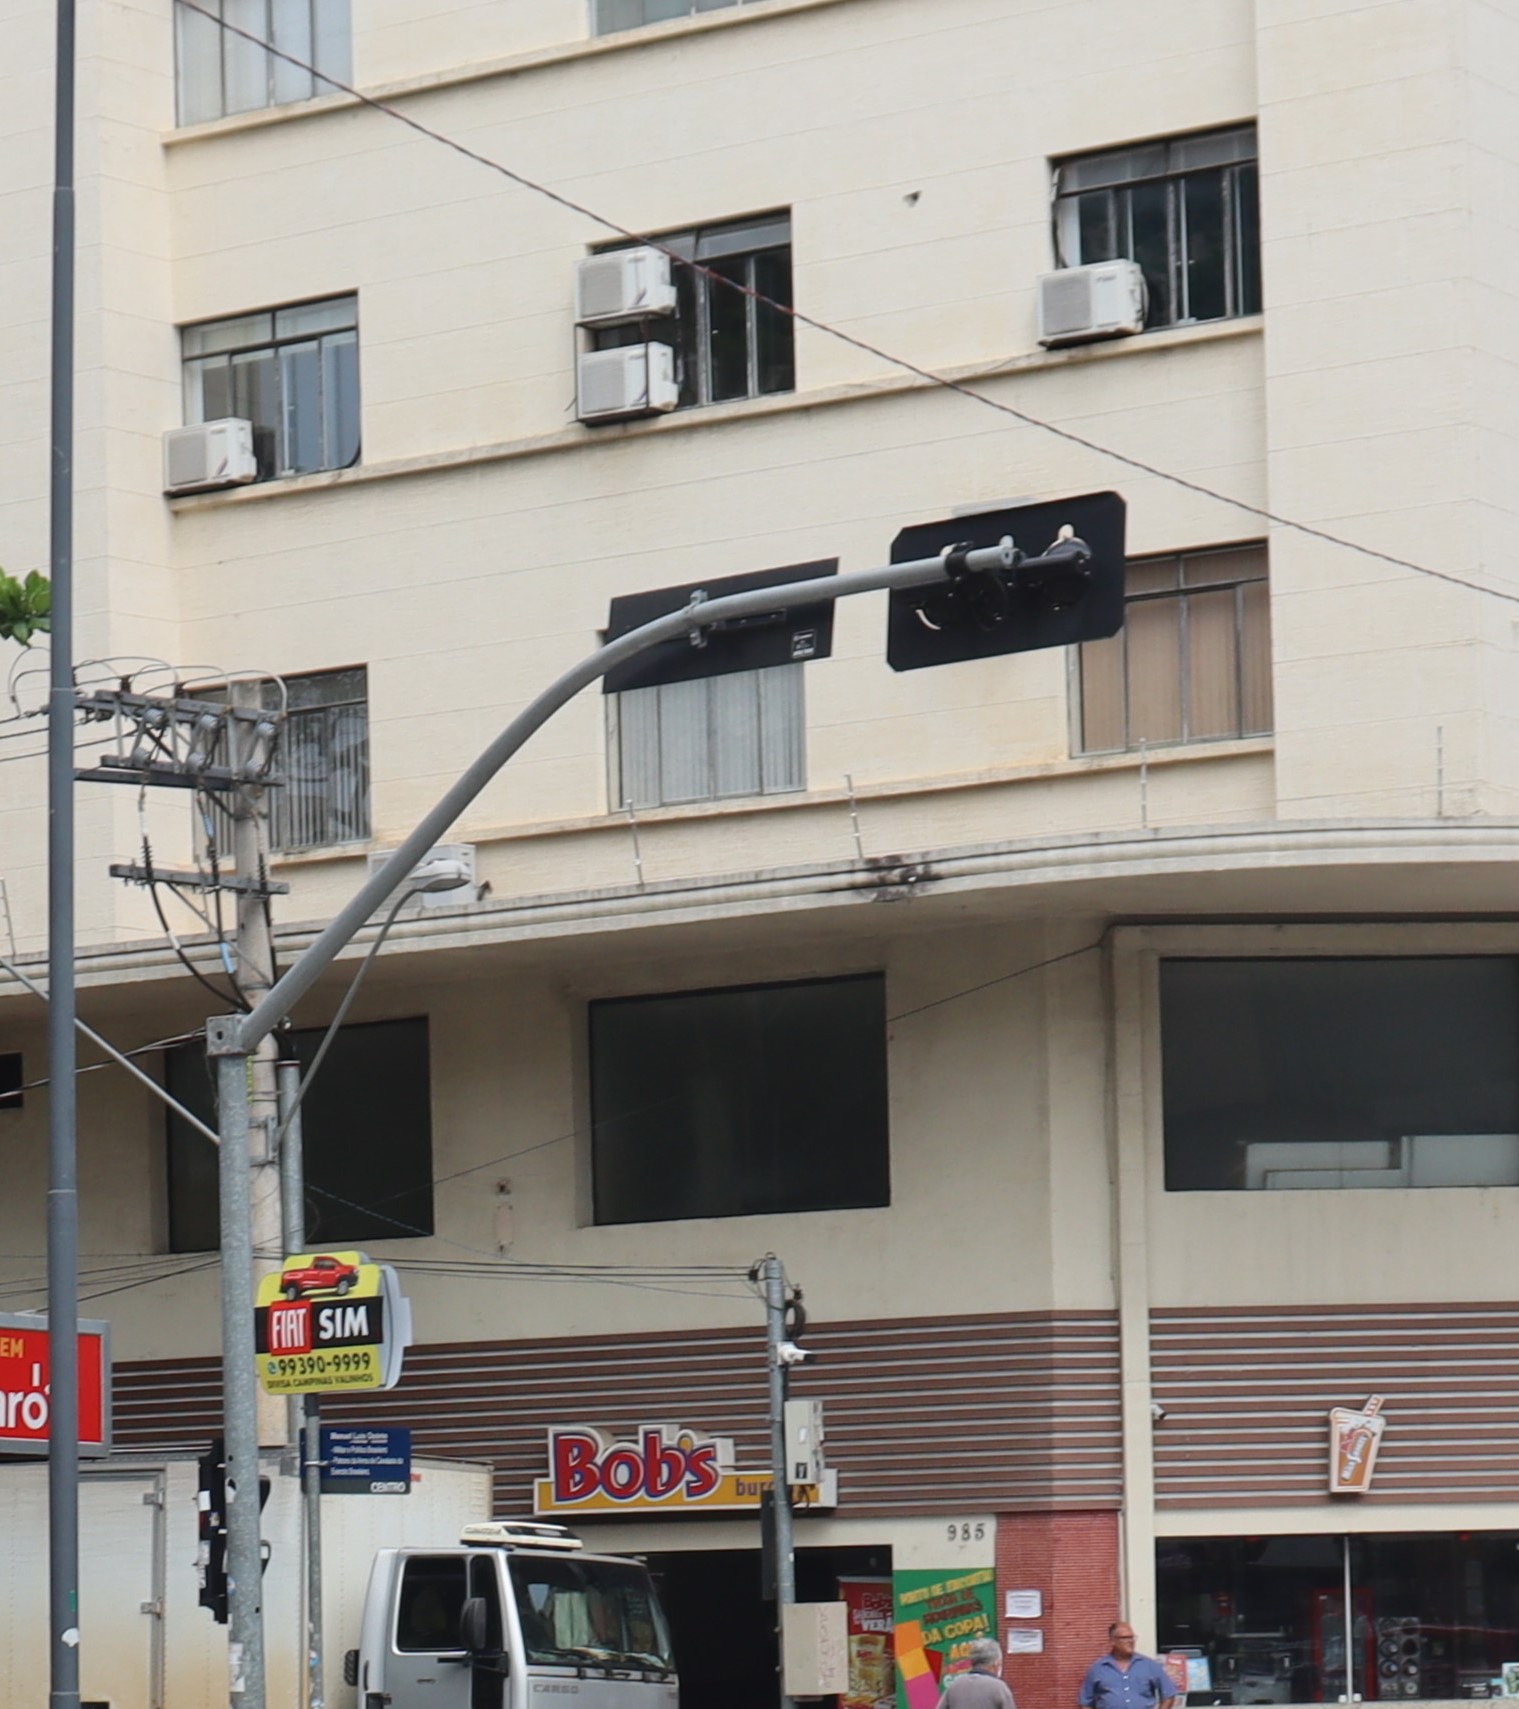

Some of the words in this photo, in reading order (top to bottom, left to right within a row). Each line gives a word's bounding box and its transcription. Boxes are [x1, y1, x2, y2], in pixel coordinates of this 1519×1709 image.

[271, 1307, 307, 1350] FIAT
[319, 1305, 370, 1340] SIM
[278, 1352, 371, 1376] 99390-9999
[554, 1430, 719, 1501] Bob's
[947, 1523, 985, 1542] 985
[922, 1628, 942, 1646] DA
[532, 1683, 580, 1695] CARGO
